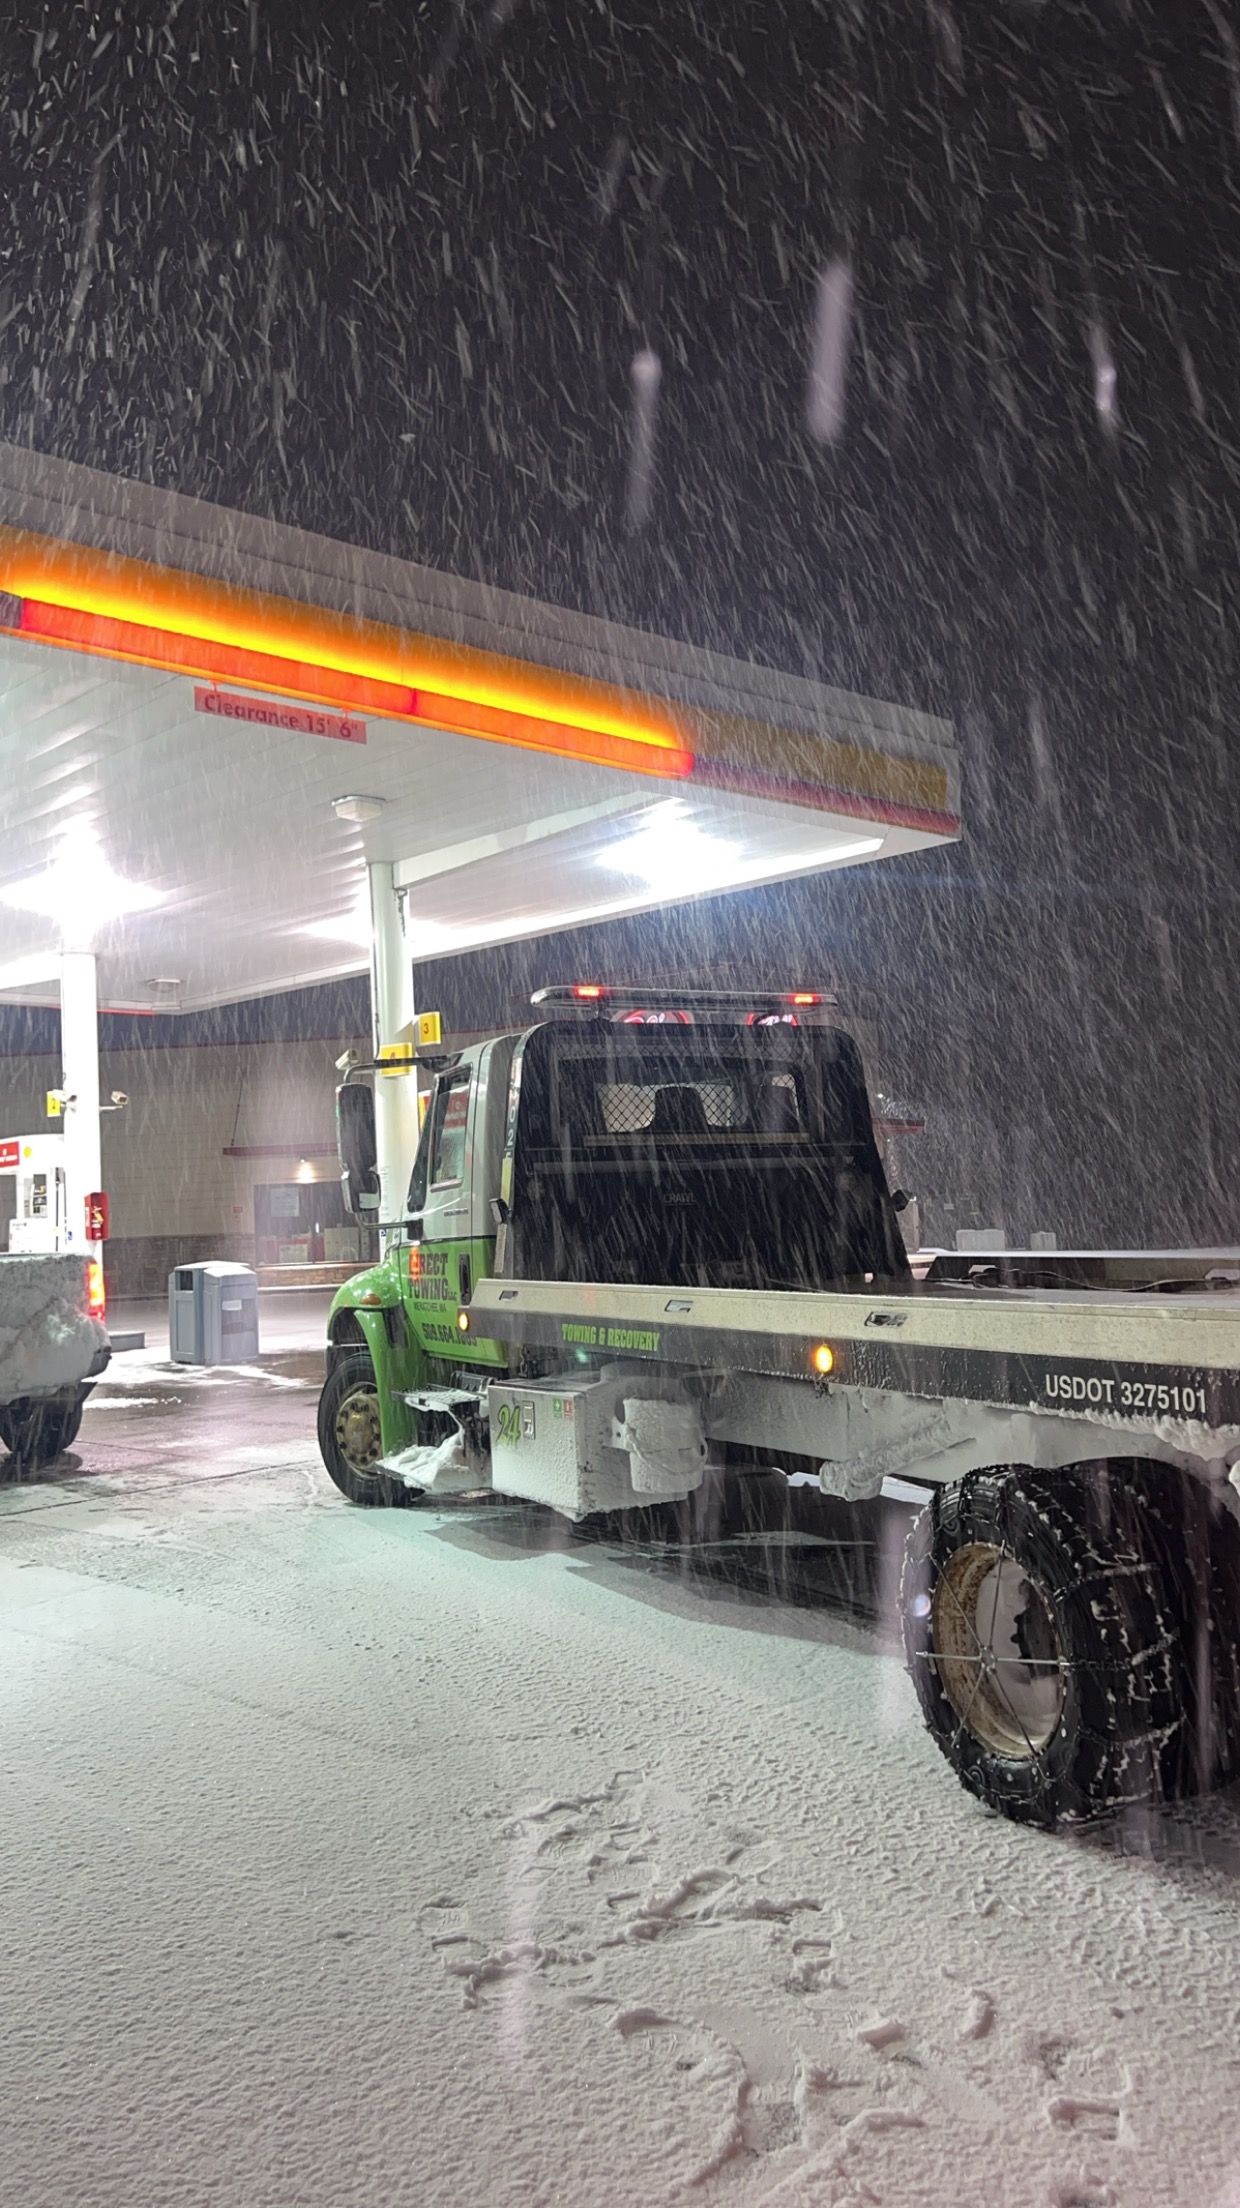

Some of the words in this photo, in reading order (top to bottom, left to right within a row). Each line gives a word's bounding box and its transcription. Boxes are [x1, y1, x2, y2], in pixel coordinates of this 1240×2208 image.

[204, 694, 300, 728] Clearance
[306, 714, 331, 734] 15'
[423, 1022, 430, 1034] 3
[408, 1278, 448, 1301] TOWING
[561, 1323, 597, 1345] TOWING
[607, 1327, 660, 1352] RECOVERY
[1045, 1374, 1115, 1403] USDOT
[1120, 1381, 1207, 1414] 3275101
